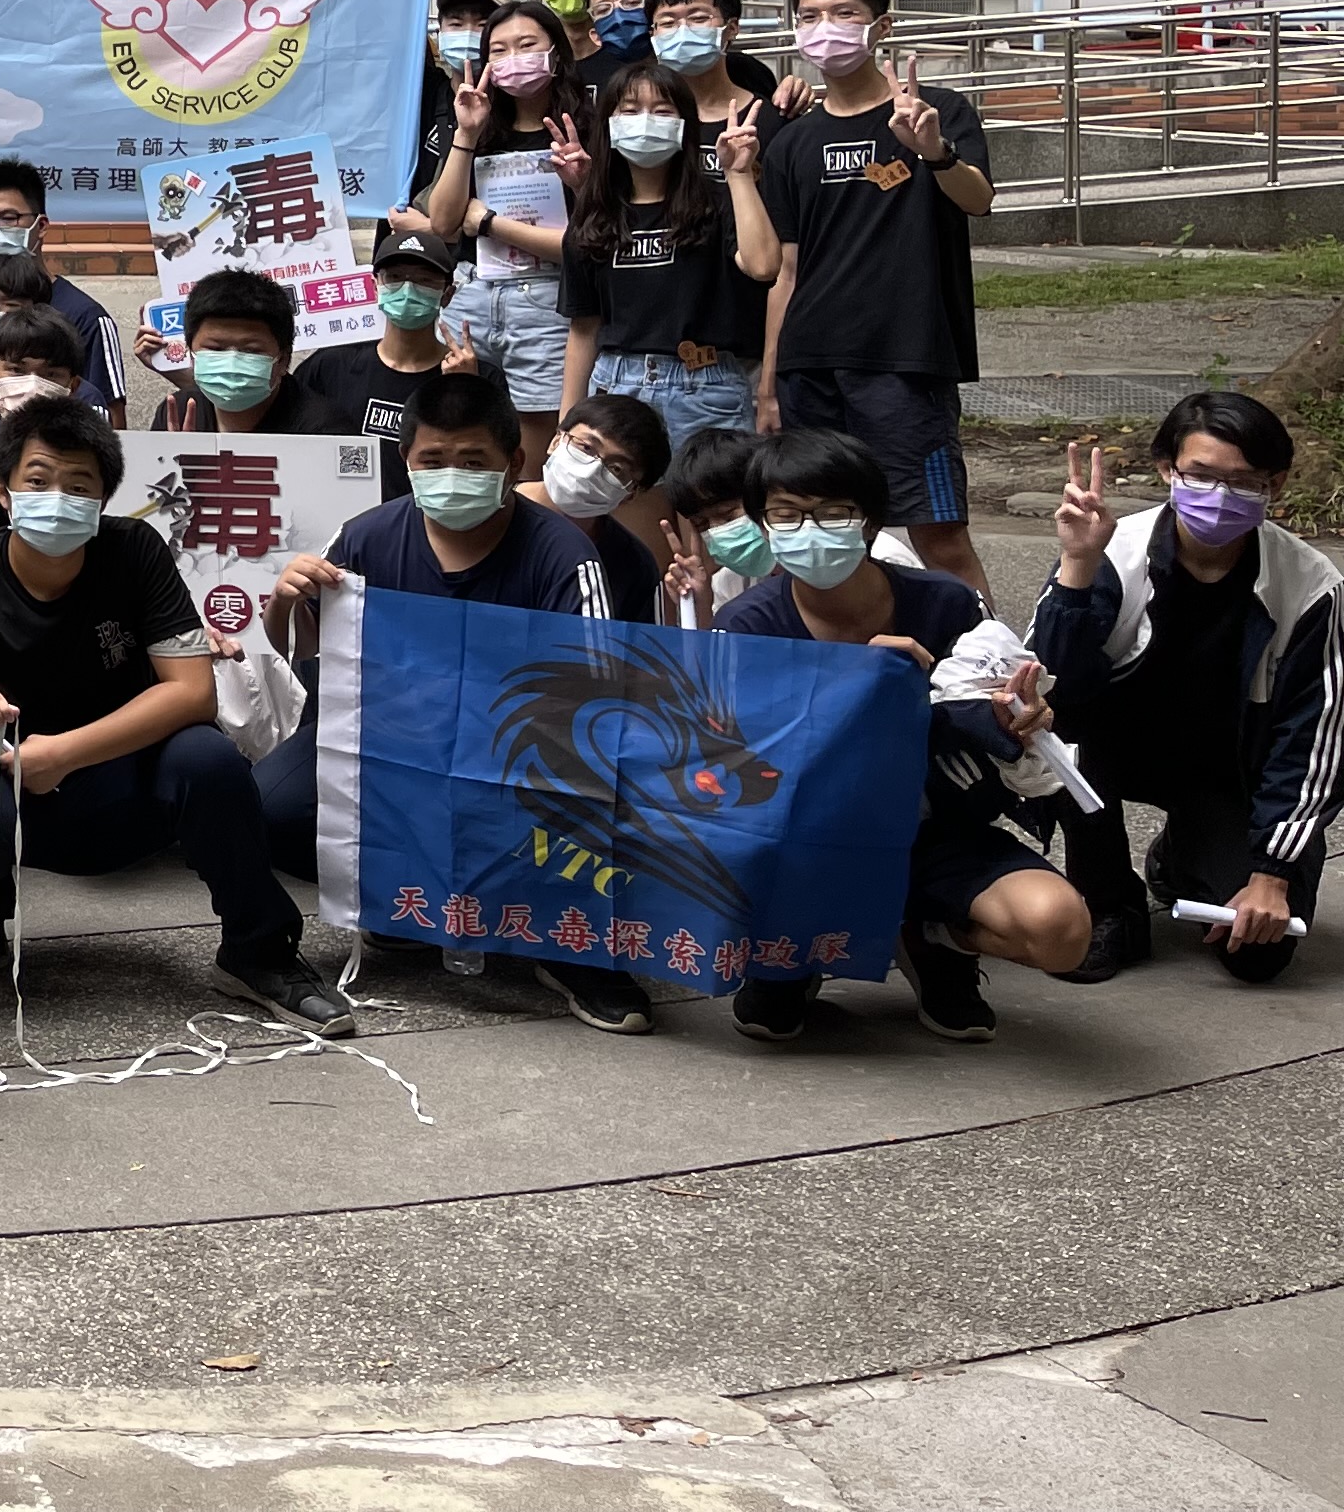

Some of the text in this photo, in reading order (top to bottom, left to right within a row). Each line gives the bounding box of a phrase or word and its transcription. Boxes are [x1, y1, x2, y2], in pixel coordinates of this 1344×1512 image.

[112, 37, 300, 116] EDU SERVICE CLUB
[115, 137, 189, 157] 高師大
[224, 150, 326, 245] 毒
[317, 278, 368, 306] 幸福
[328, 314, 376, 334] 關心您
[176, 449, 281, 557] 毒
[510, 824, 635, 899] NTC
[390, 886, 851, 982] 天龍反毒探索特攻隊
